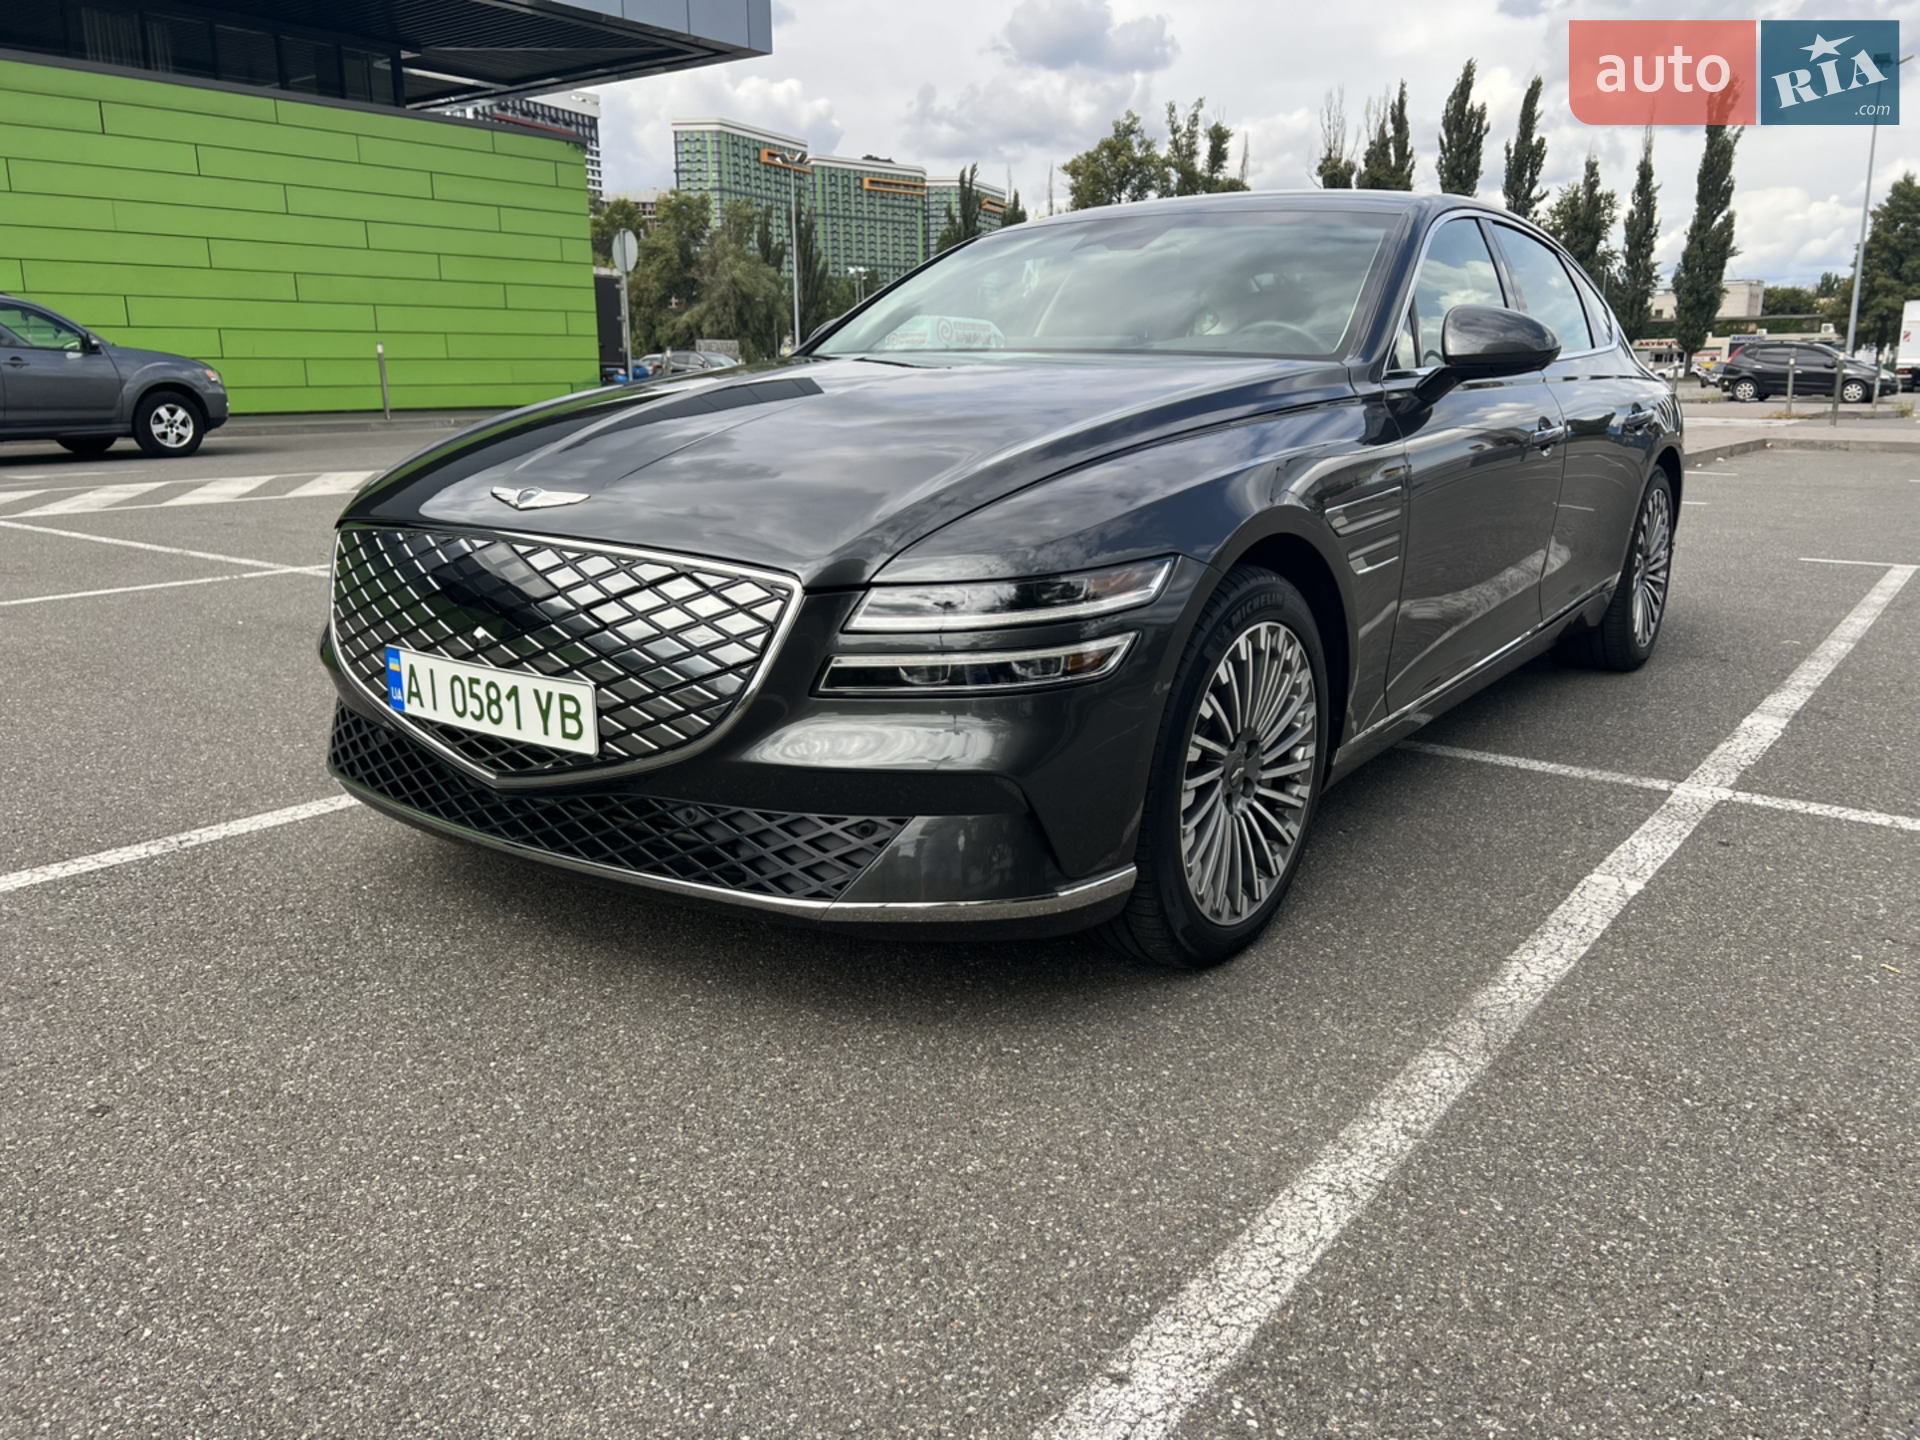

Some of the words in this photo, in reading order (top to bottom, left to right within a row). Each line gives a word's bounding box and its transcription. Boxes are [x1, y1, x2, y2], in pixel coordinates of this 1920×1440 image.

[1231, 593, 1283, 627] MICHELIN
[391, 686, 403, 701] UA
[406, 663, 438, 711] AI
[450, 674, 522, 731] 0581
[532, 688, 584, 741] YB
